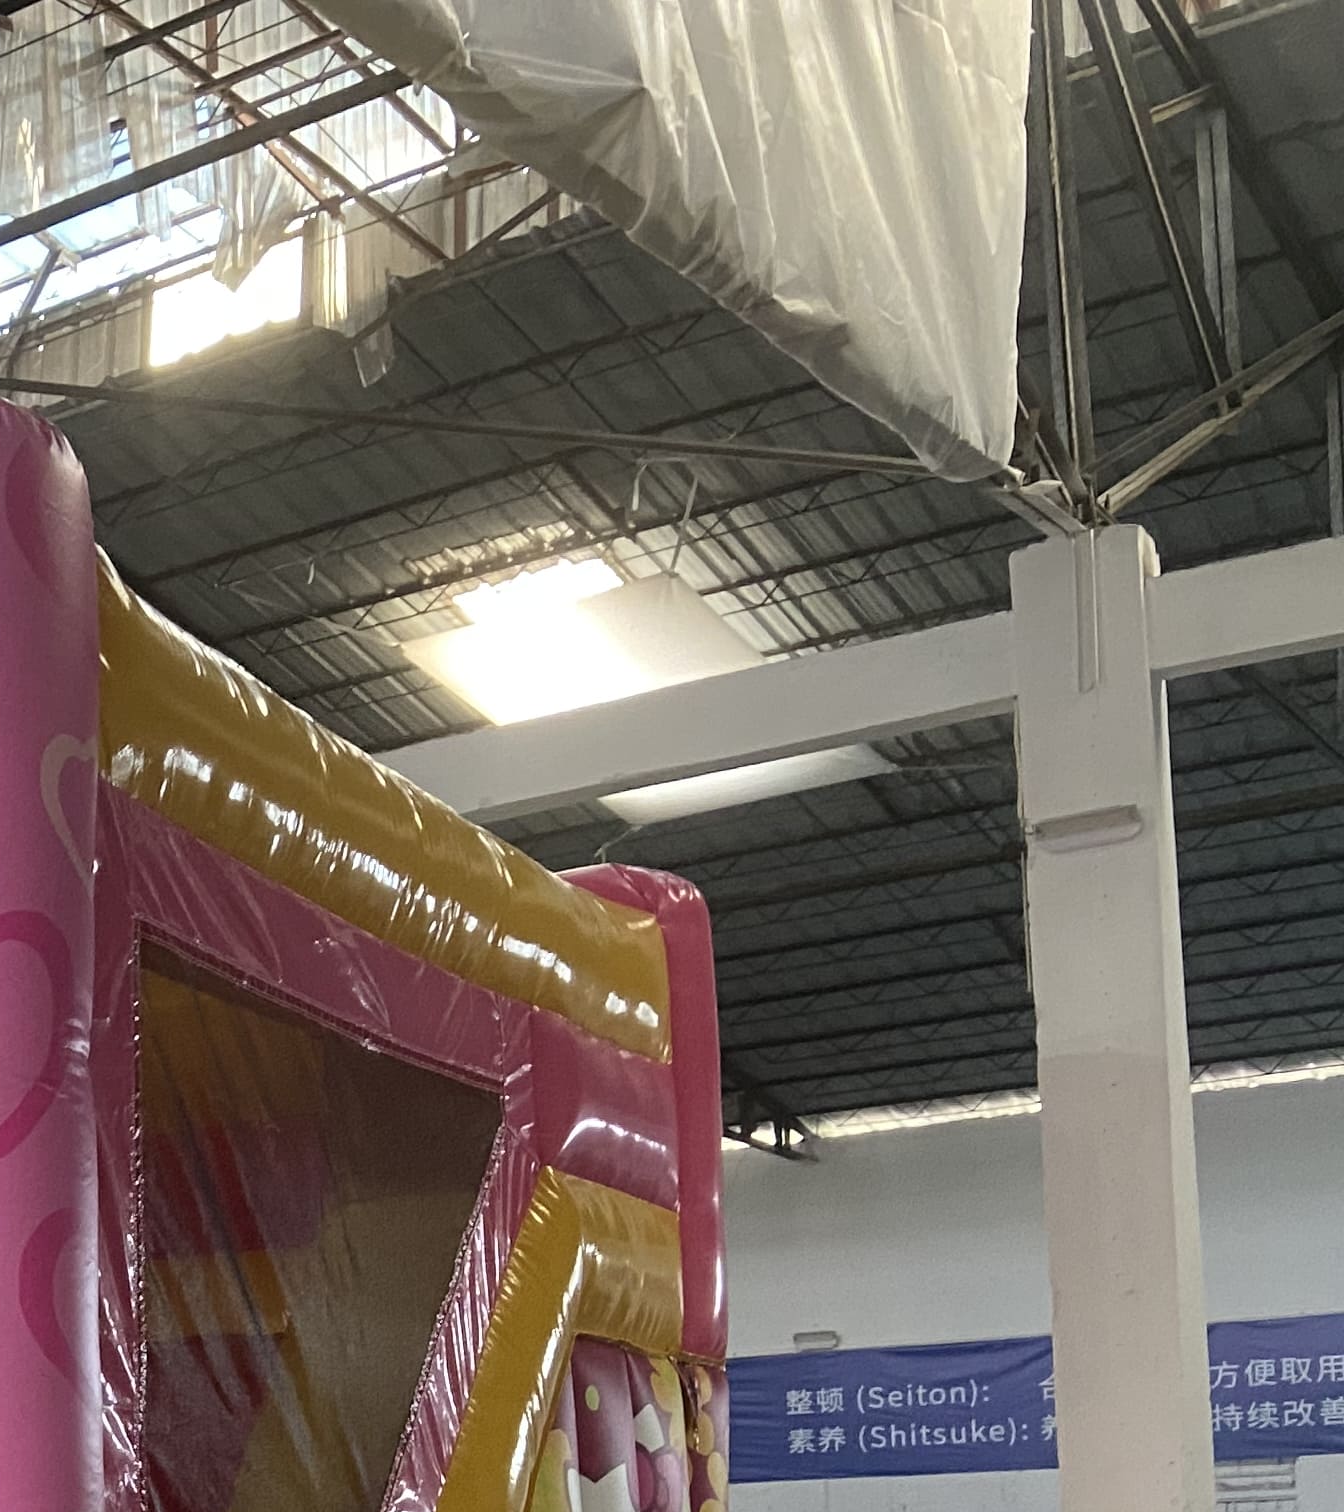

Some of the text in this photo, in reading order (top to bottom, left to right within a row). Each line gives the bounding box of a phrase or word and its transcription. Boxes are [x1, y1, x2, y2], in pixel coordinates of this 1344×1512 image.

[786, 1387, 845, 1416] 整顿
[857, 1379, 990, 1413] (Seiton):
[1209, 1354, 1344, 1389] 方便取用
[788, 1426, 846, 1454] 素养
[858, 1417, 1028, 1452] (Shitsuke):
